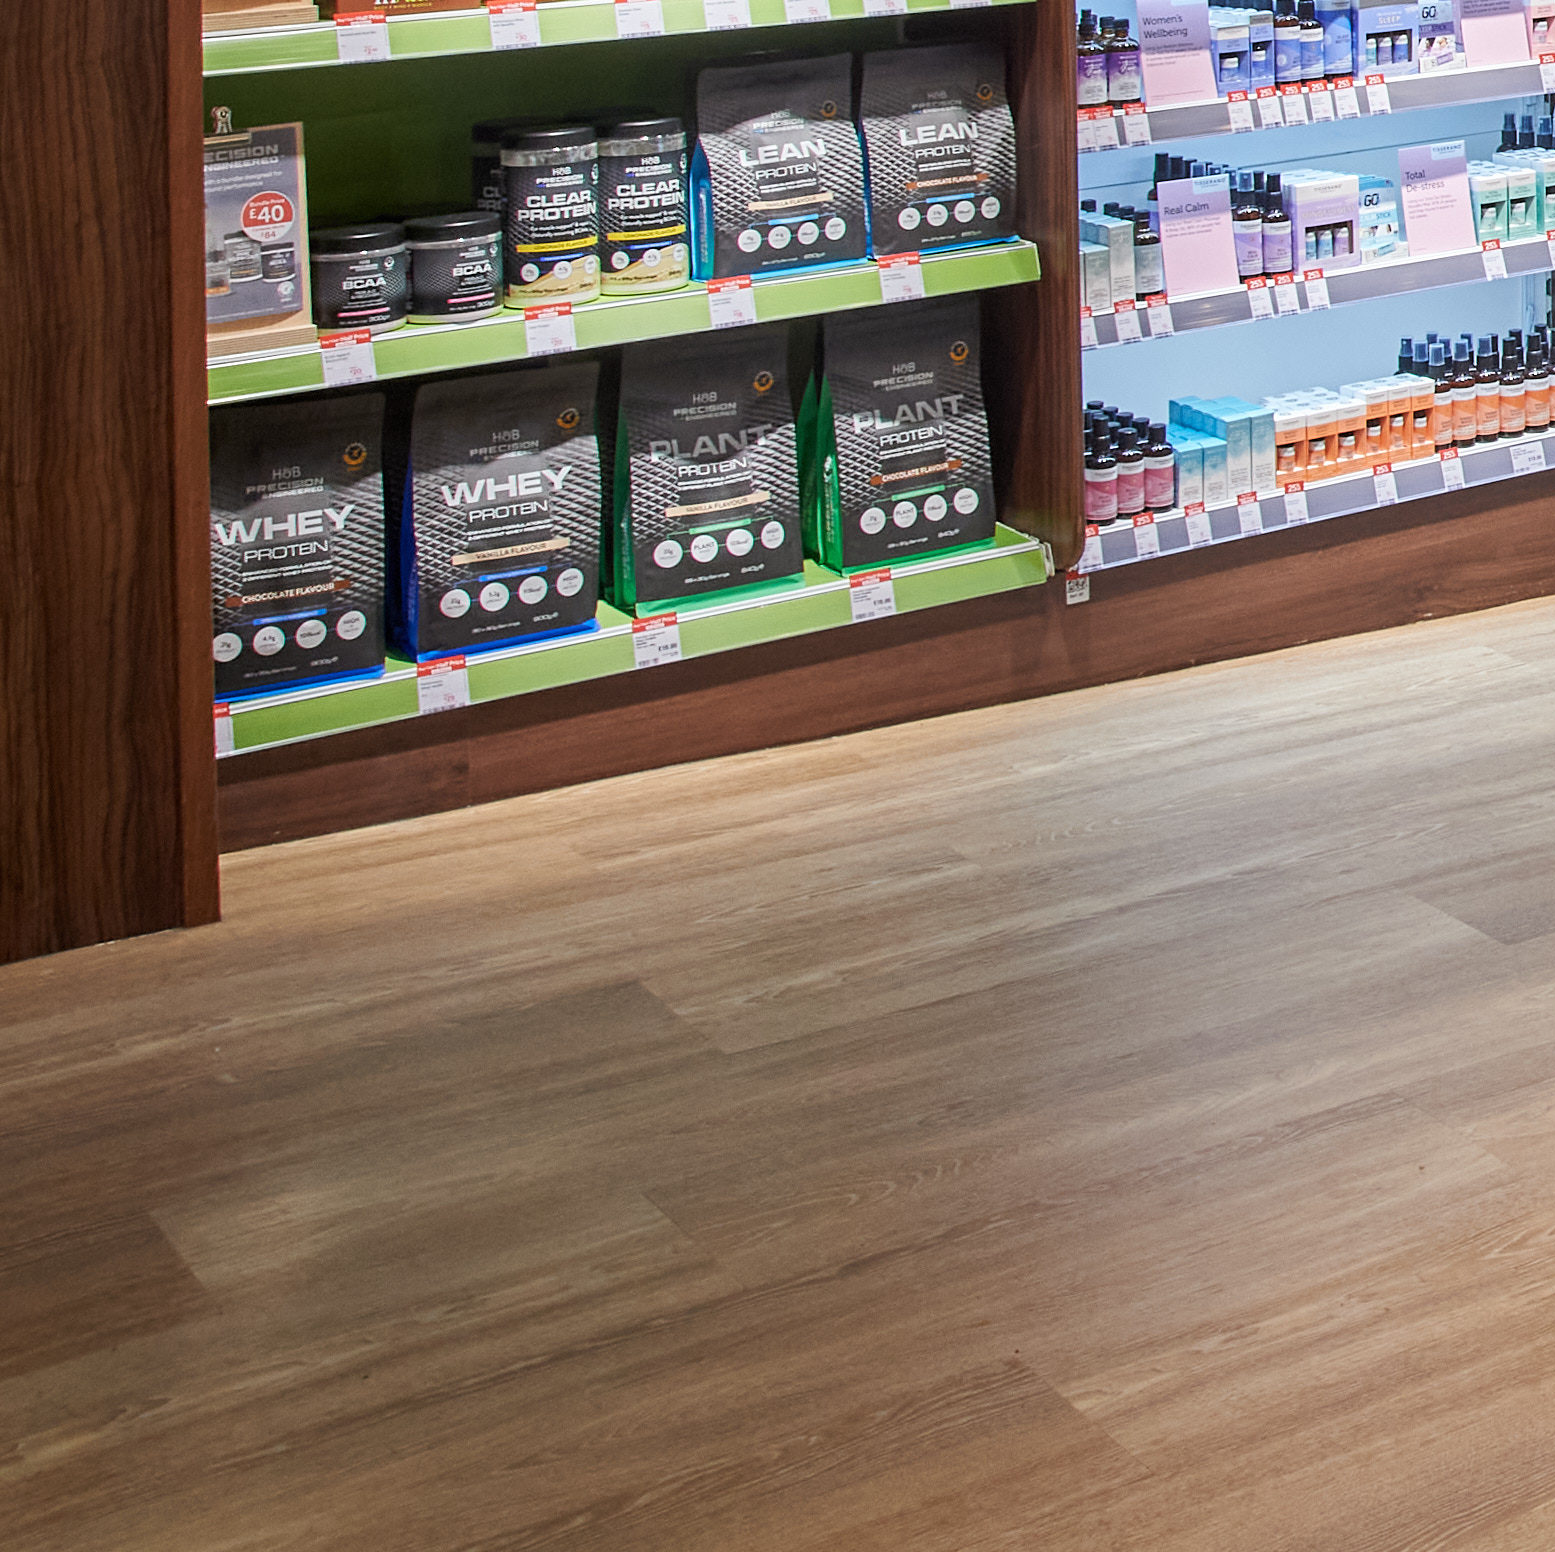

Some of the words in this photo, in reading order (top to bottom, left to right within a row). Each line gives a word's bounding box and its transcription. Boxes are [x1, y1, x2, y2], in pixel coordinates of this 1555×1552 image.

[900, 122, 978, 146] LEAN
[526, 190, 592, 208] CLEAR
[1164, 204, 1186, 216] Real
[1189, 201, 1210, 214] Calm
[249, 205, 284, 223] £40
[518, 202, 596, 221] PROTEIN
[854, 395, 963, 433] PLANT
[215, 504, 355, 547] WHEY
[243, 540, 329, 565] PROTEIN
